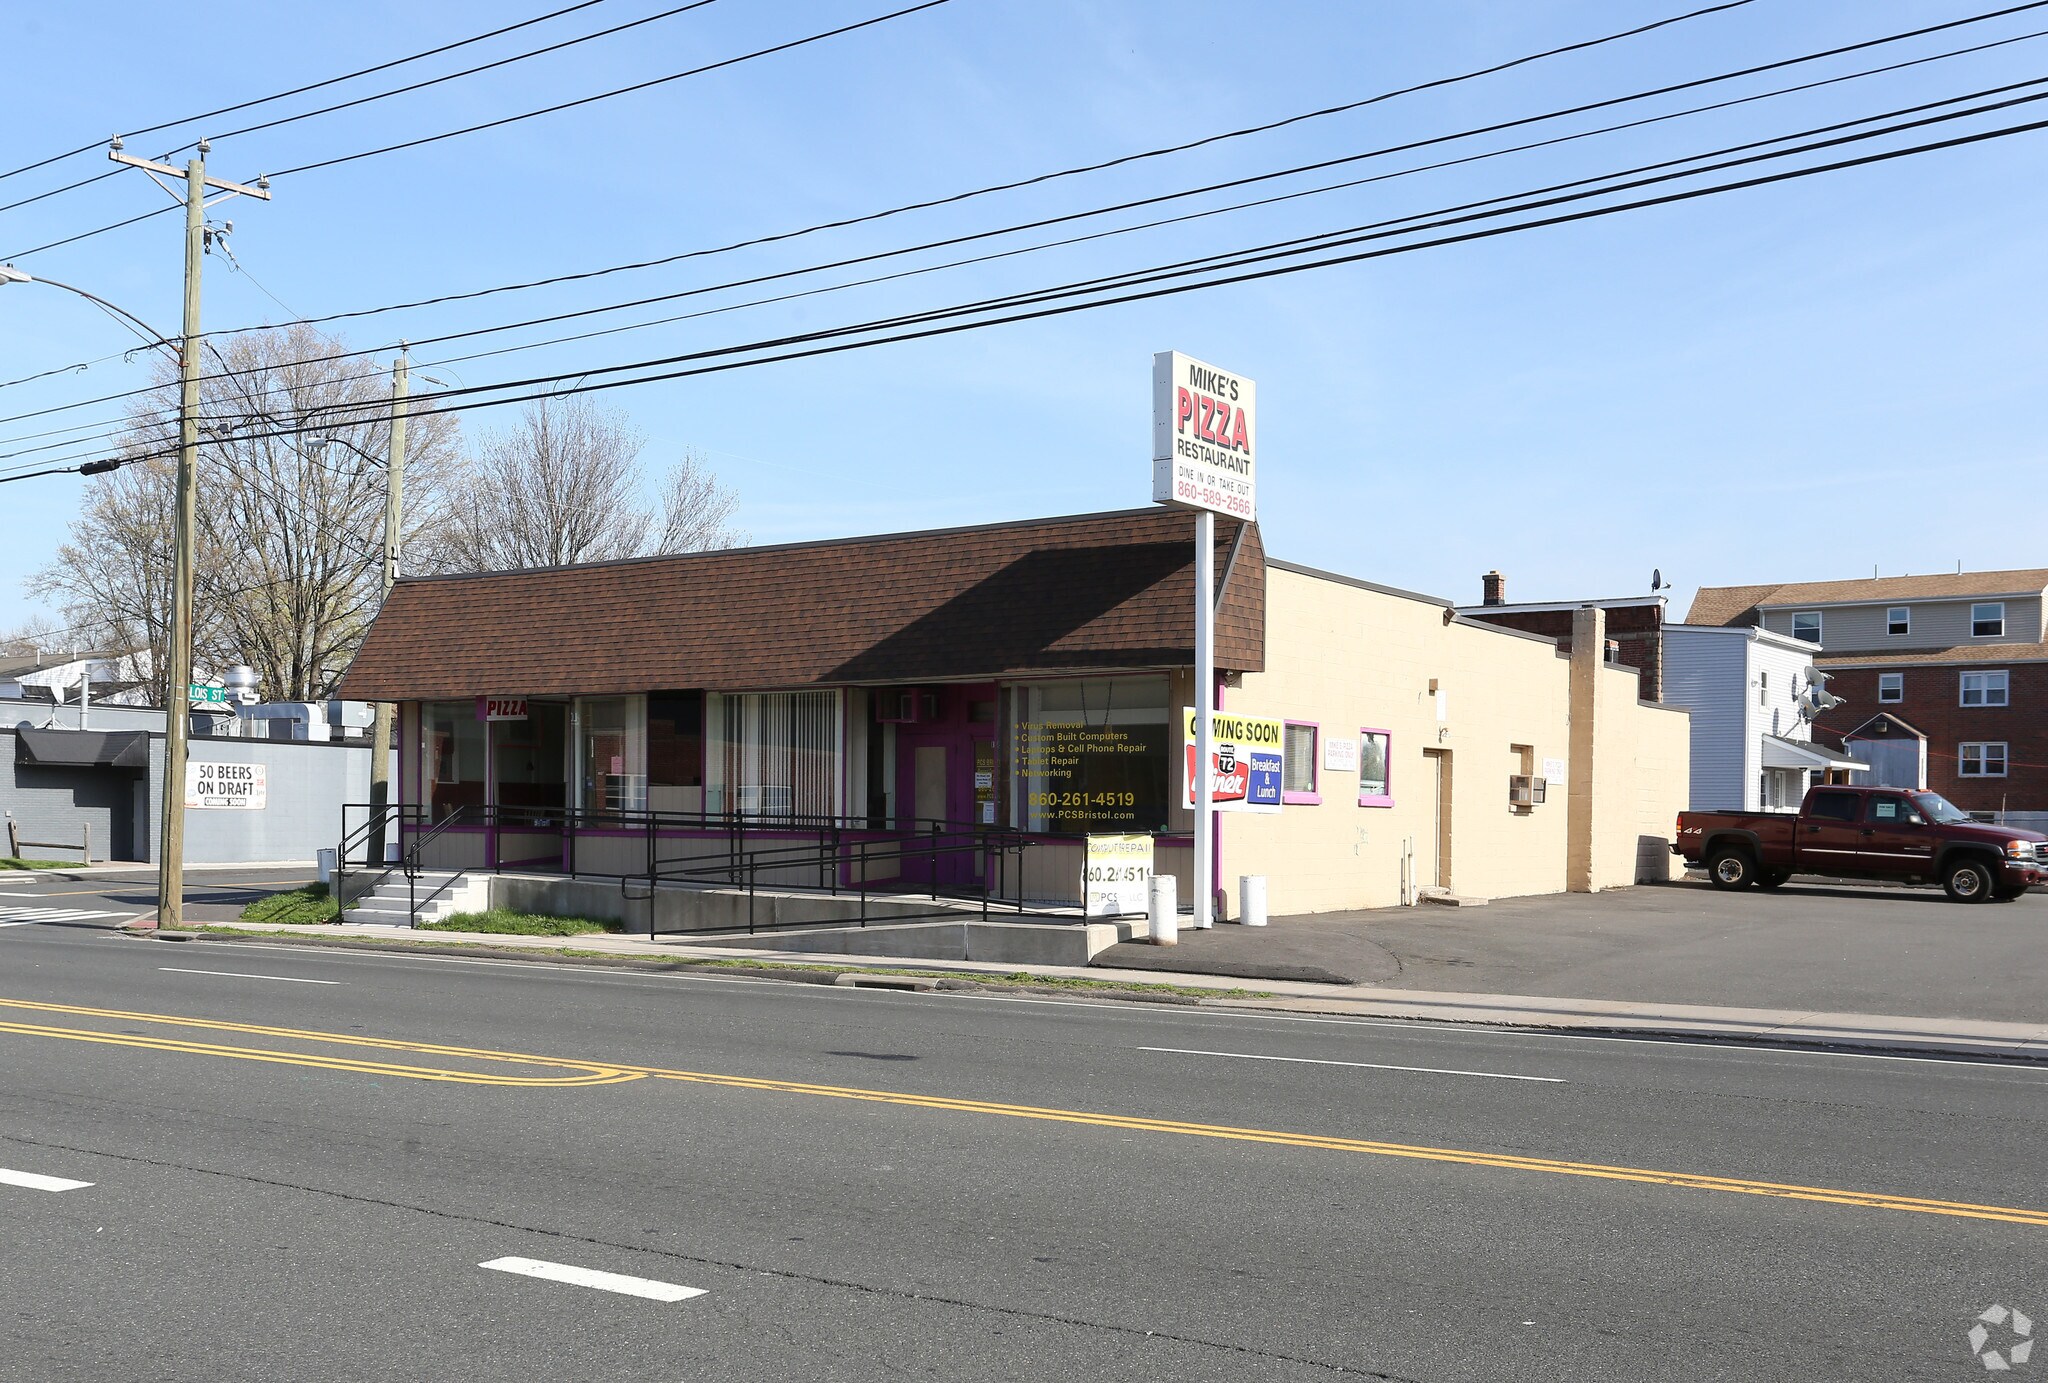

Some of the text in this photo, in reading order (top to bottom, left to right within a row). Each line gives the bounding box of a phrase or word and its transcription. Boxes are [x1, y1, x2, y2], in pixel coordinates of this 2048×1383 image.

[1189, 364, 1239, 401] MIKE'S
[1177, 385, 1250, 456] PIZZA
[1177, 438, 1251, 476] RESTAURANT
[1179, 466, 1250, 497] DINE IN OR TAKE OUT
[1178, 480, 1251, 516] 860-589-2566
[190, 686, 223, 700] LOIS ST
[487, 700, 528, 716] PIZZA
[1022, 721, 1084, 730] Virus Removal
[1190, 716, 1279, 743] CMING SOON
[1021, 732, 1128, 744] Custom Built Computers
[1021, 743, 1147, 756] Laptops & Cell Phone Repair
[1022, 756, 1079, 766] Tablet Repair
[1252, 758, 1281, 773] Breakfast
[200, 765, 252, 780] 50 BEERS
[1021, 769, 1072, 778] Networking
[1265, 772, 1270, 785] &
[197, 781, 214, 794] ON
[219, 782, 254, 795] DRAFT
[1257, 785, 1276, 798] Lunch
[205, 798, 228, 806] COMING
[229, 798, 246, 806] SOON
[1029, 792, 1134, 806] 860-261-4519
[1030, 810, 1135, 820] www.PCSBristol.com
